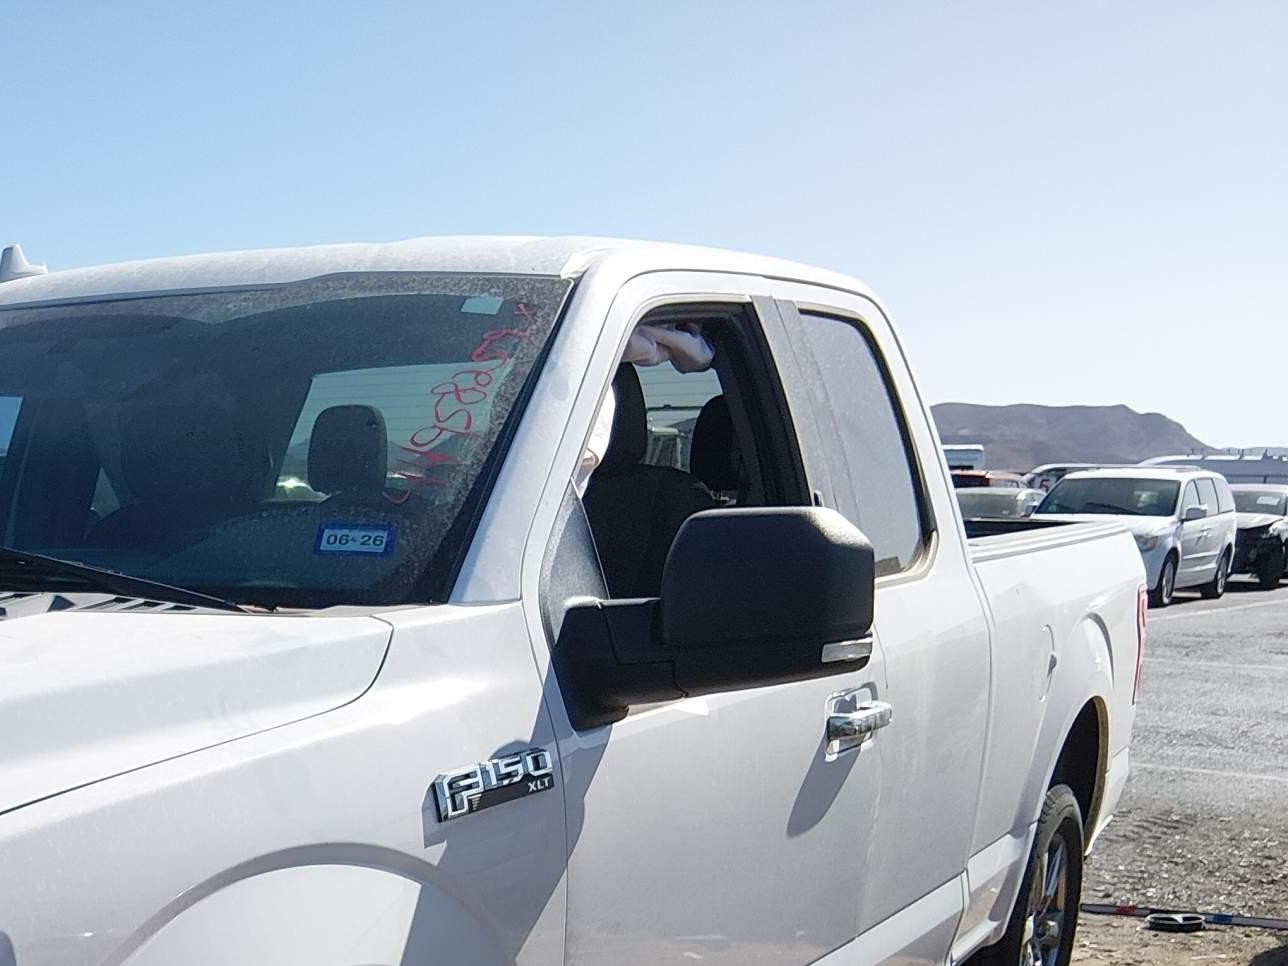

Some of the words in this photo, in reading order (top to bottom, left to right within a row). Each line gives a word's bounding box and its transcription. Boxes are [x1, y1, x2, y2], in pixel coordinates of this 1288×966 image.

[325, 533, 350, 546] 06
[359, 533, 385, 547] 26
[527, 775, 551, 794] XLT
